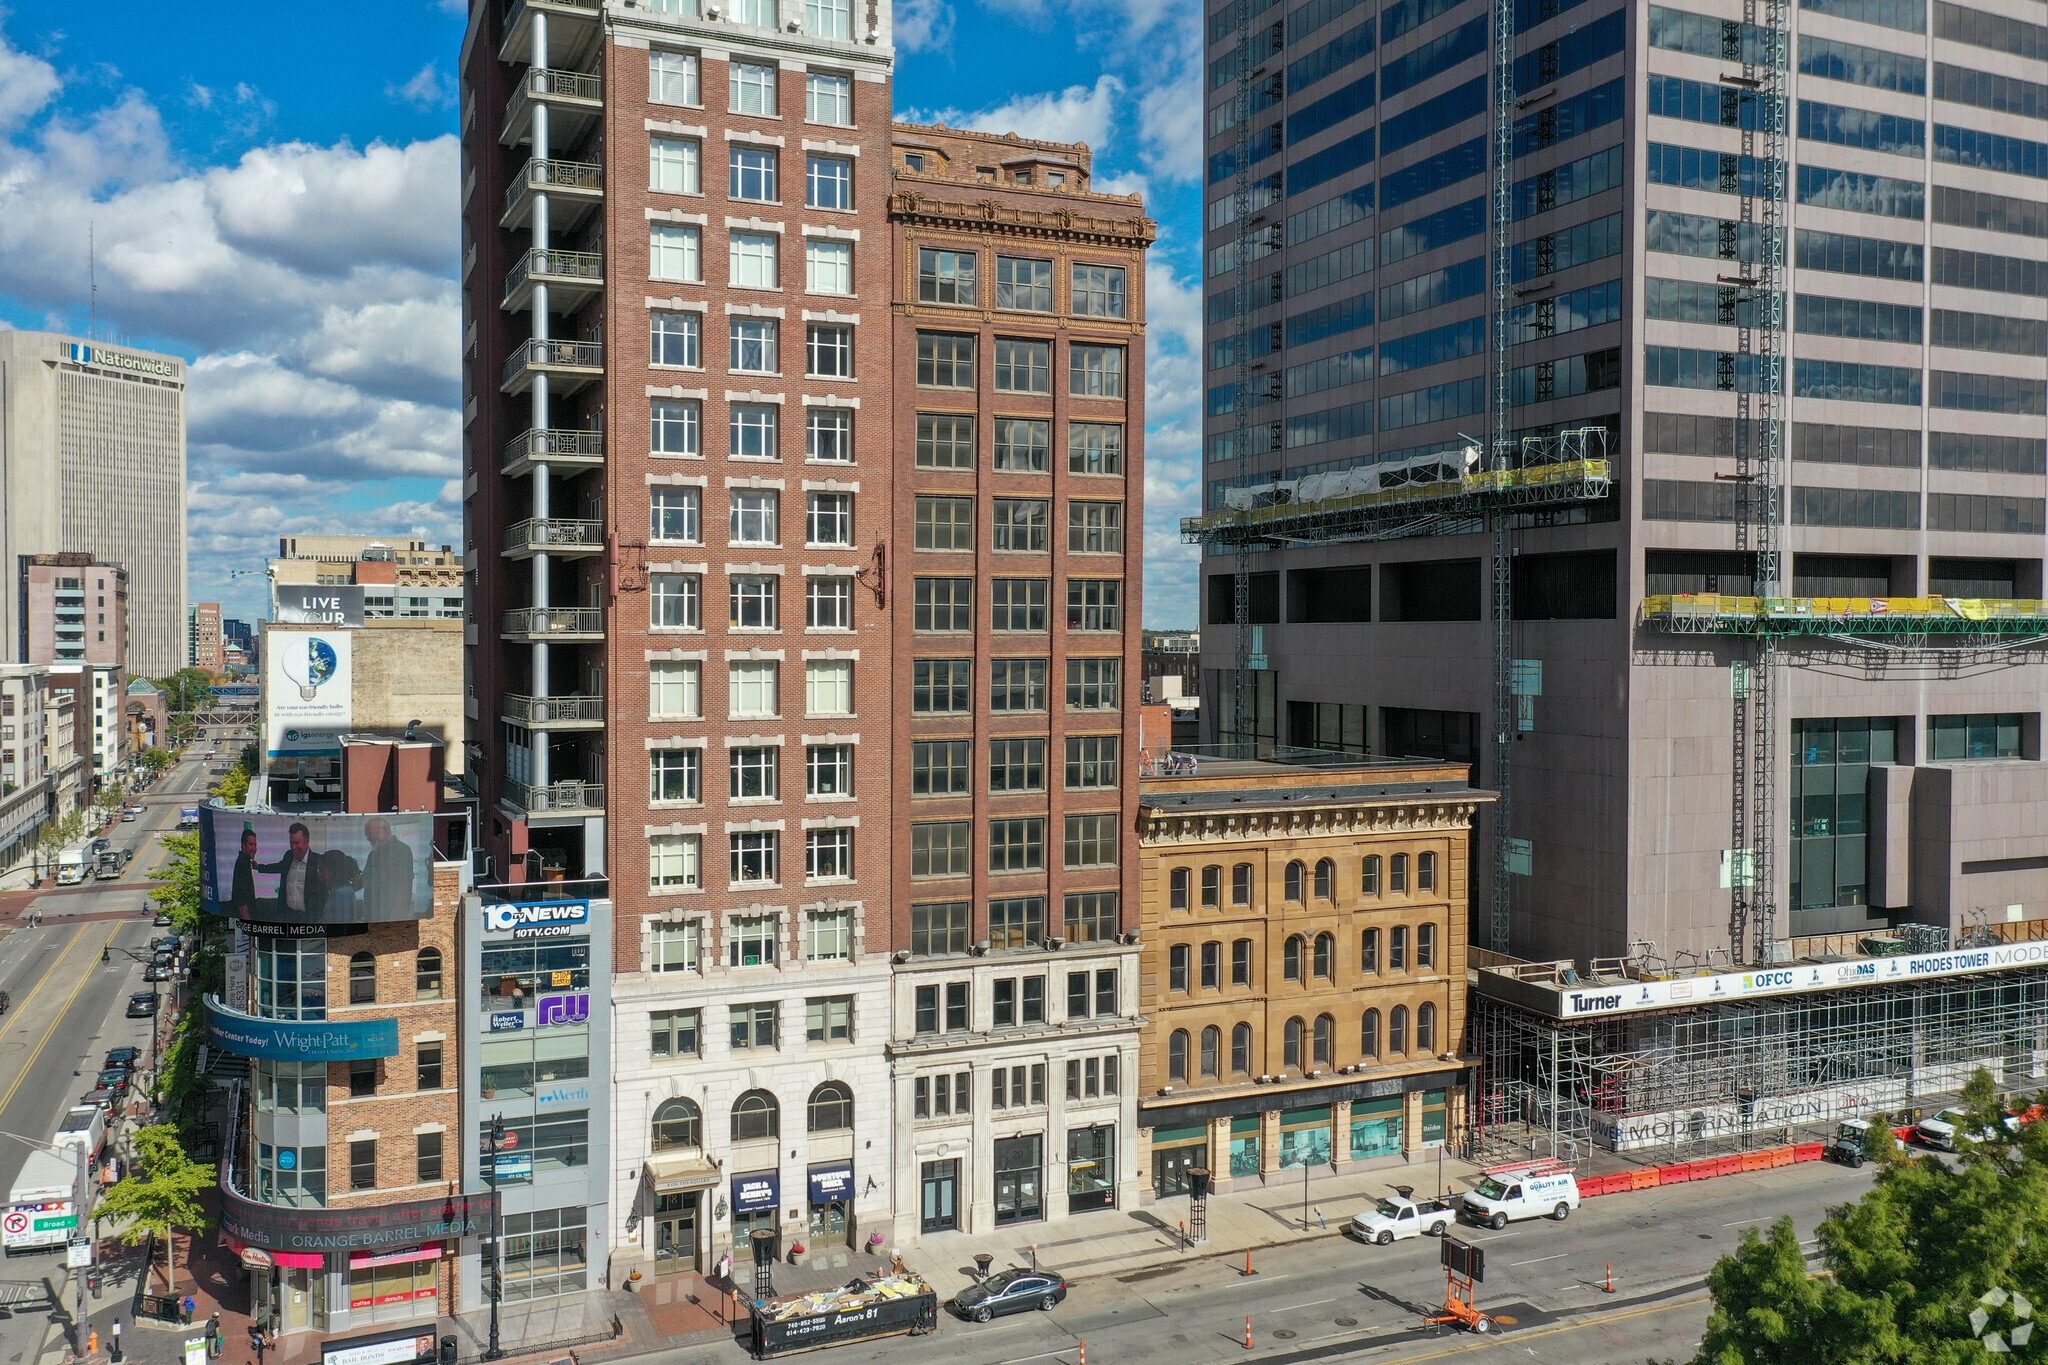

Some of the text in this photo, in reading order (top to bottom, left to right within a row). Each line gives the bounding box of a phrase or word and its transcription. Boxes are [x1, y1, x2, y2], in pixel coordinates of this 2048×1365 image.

[94, 349, 172, 376] Nationwide
[302, 597, 341, 609] LIVE
[299, 611, 345, 624] YOUR
[300, 731, 335, 739] igsenergy
[484, 904, 519, 930] 10
[519, 905, 585, 923] NEWS
[252, 923, 285, 935] BARREL
[290, 925, 326, 935] MEDIA
[515, 926, 570, 938] 10TV.COM
[1910, 956, 1952, 974] RHODES
[1954, 953, 1989, 969] TOWER
[1755, 971, 1793, 987] OFCC
[1570, 993, 1622, 1012] Turner
[492, 1014, 517, 1022] Robert
[224, 1030, 245, 1042] Center
[245, 1034, 269, 1048] Today!
[552, 1087, 589, 1101] Werth
[811, 1170, 851, 1182] DOWNTOWN
[743, 1182, 761, 1192] JACK
[821, 1179, 844, 1188] DINER
[1529, 1181, 1555, 1191] QUALITY
[671, 1195, 678, 1203] 8
[277, 1214, 343, 1228] suspends
[347, 1211, 387, 1226] travel
[393, 1207, 425, 1221] after
[43, 1220, 66, 1228] Broad
[241, 1226, 270, 1244] Media
[292, 1220, 476, 1248] ORANGE BARREL MEDIA
[352, 1299, 371, 1307] coffee
[384, 1295, 404, 1303] donuts
[834, 1308, 878, 1325] Aaron's 81
[342, 1355, 357, 1364] BAIL
[360, 1353, 385, 1361] BONDS
